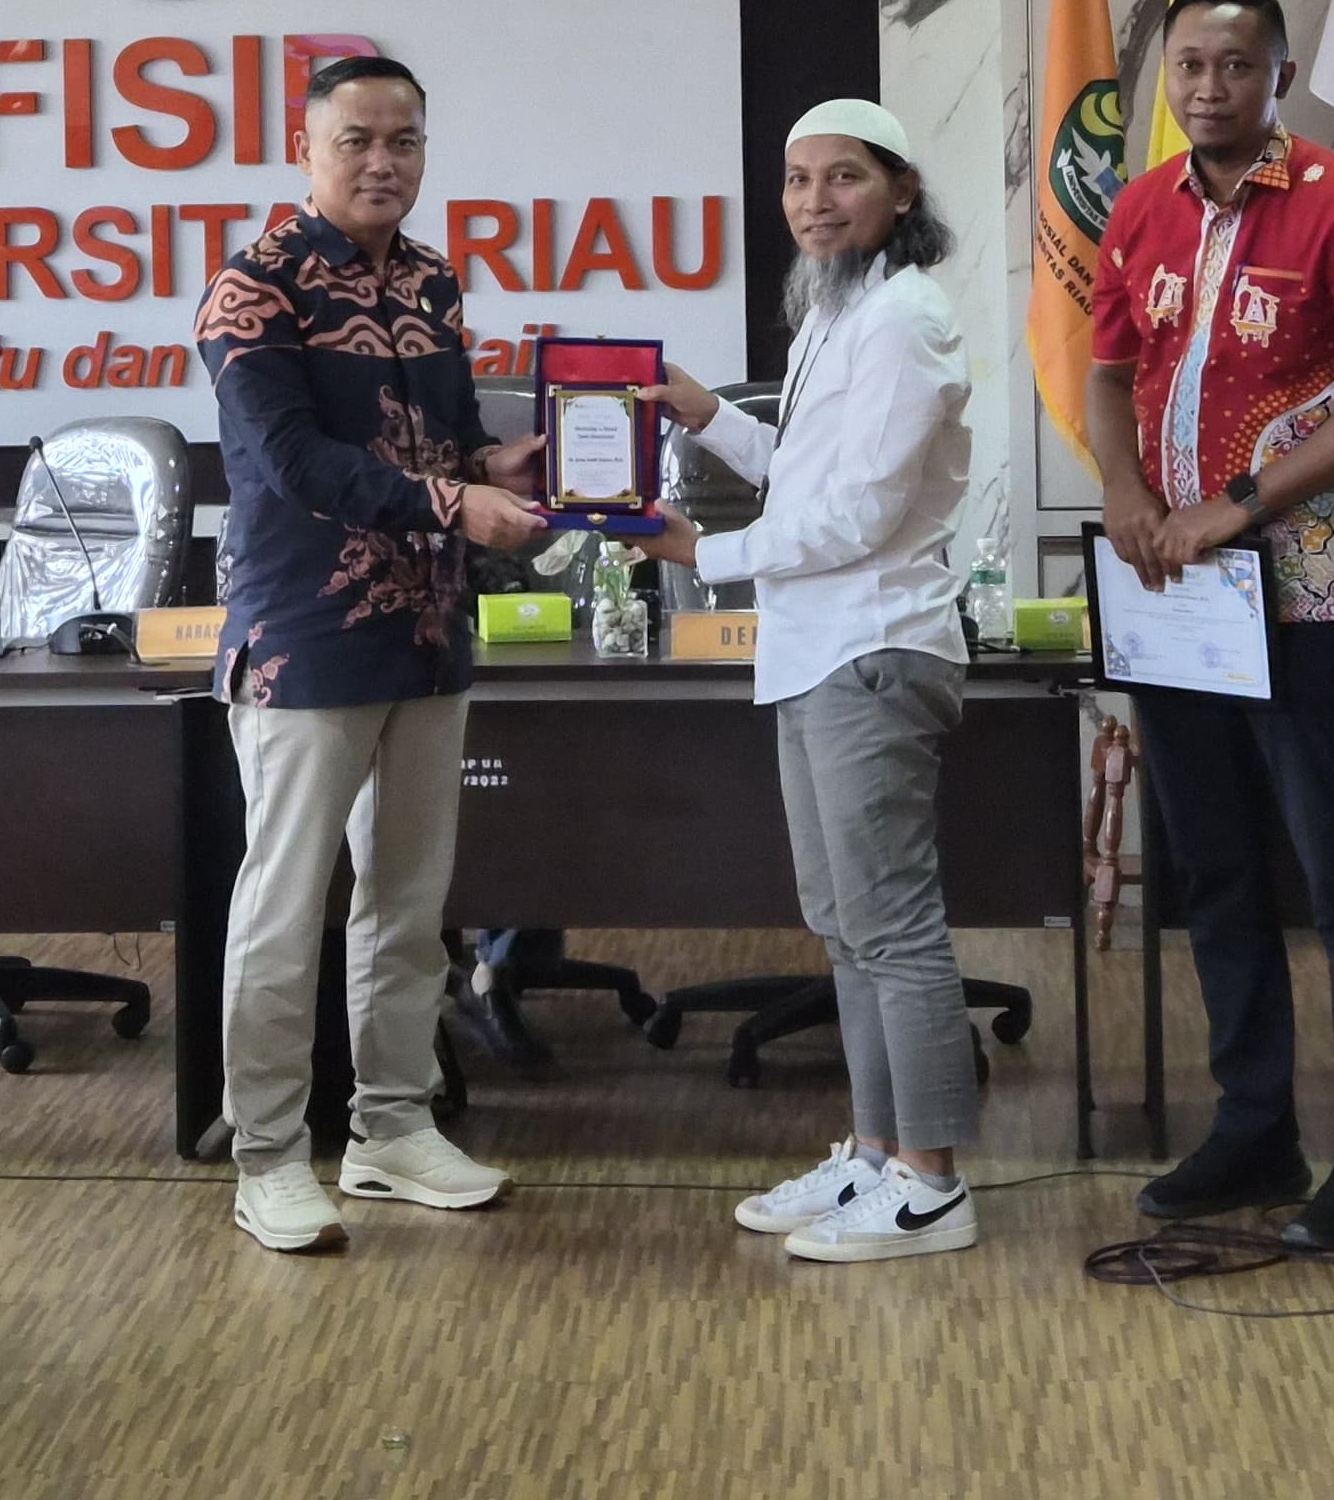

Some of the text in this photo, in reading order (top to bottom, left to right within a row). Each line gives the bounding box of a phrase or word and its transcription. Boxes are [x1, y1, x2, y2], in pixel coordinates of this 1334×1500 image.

[446, 196, 723, 292] RIAU
[1067, 256, 1094, 287] DAN
[63, 331, 188, 389] dan
